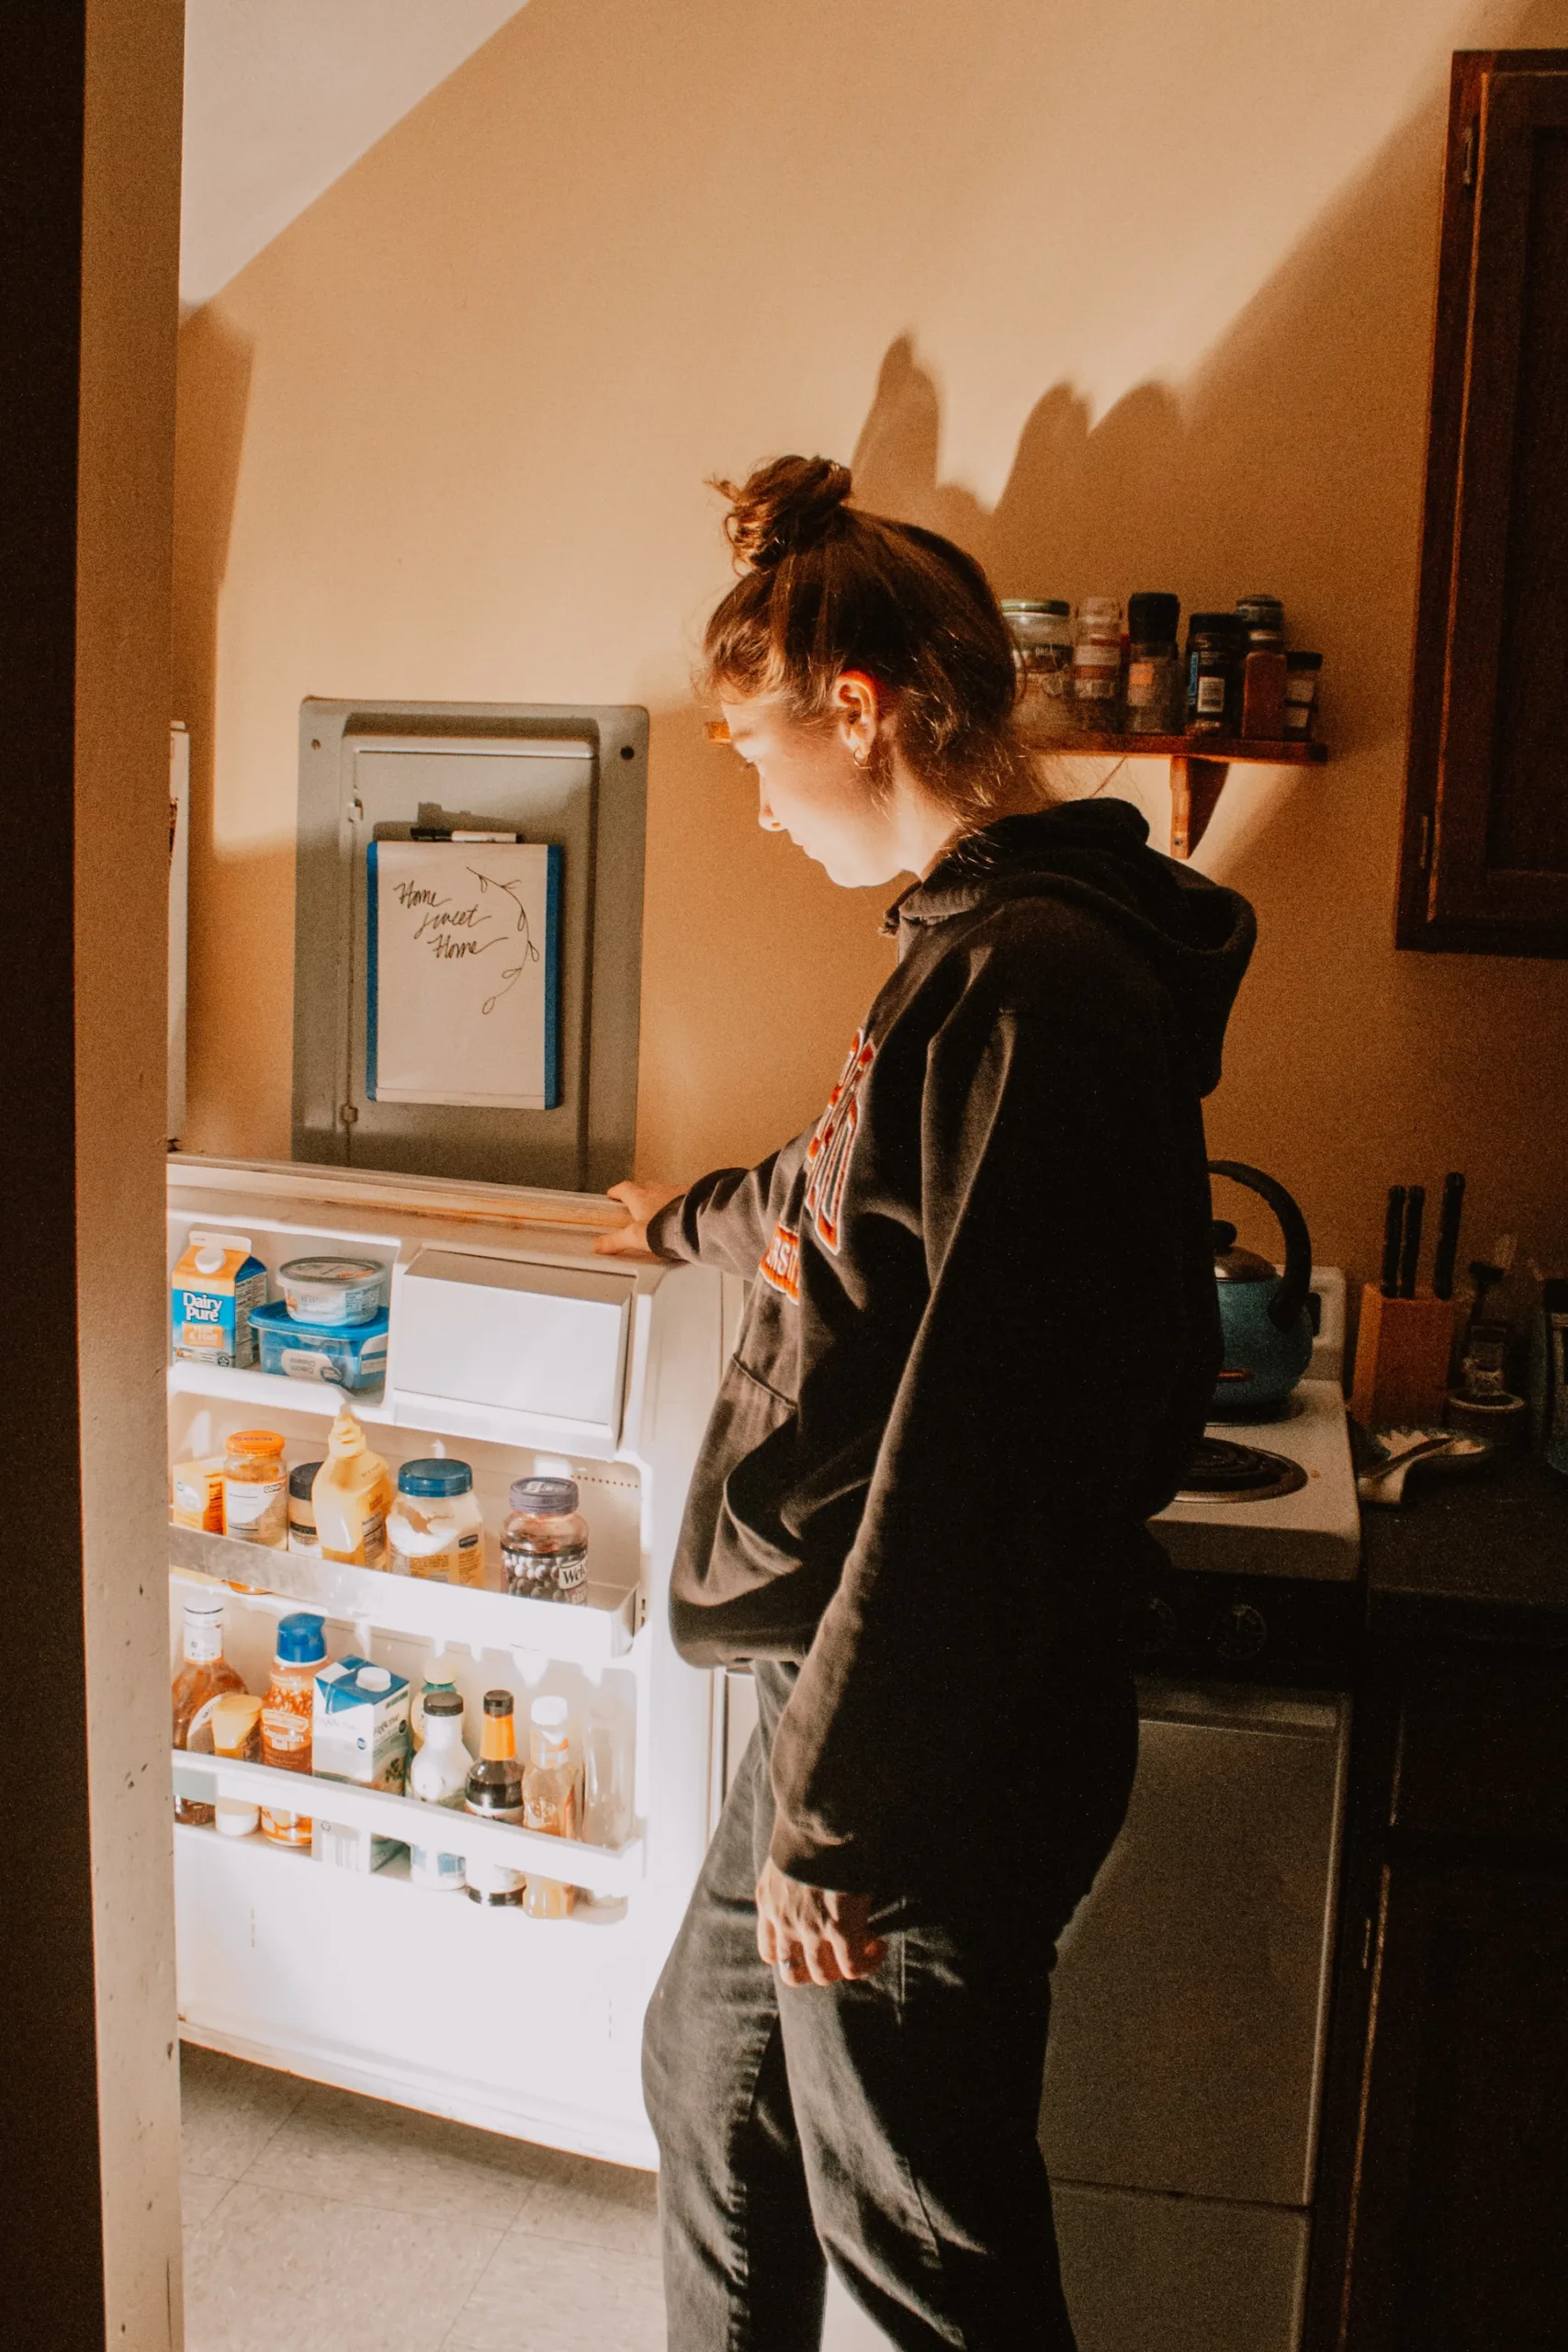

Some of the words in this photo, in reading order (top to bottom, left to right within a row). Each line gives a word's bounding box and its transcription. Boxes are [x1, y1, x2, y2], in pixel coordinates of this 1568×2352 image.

[392, 880, 452, 910] Home
[426, 933, 510, 959] Home
[182, 1292, 223, 1313] Dairy
[186, 1306, 219, 1323] Pure
